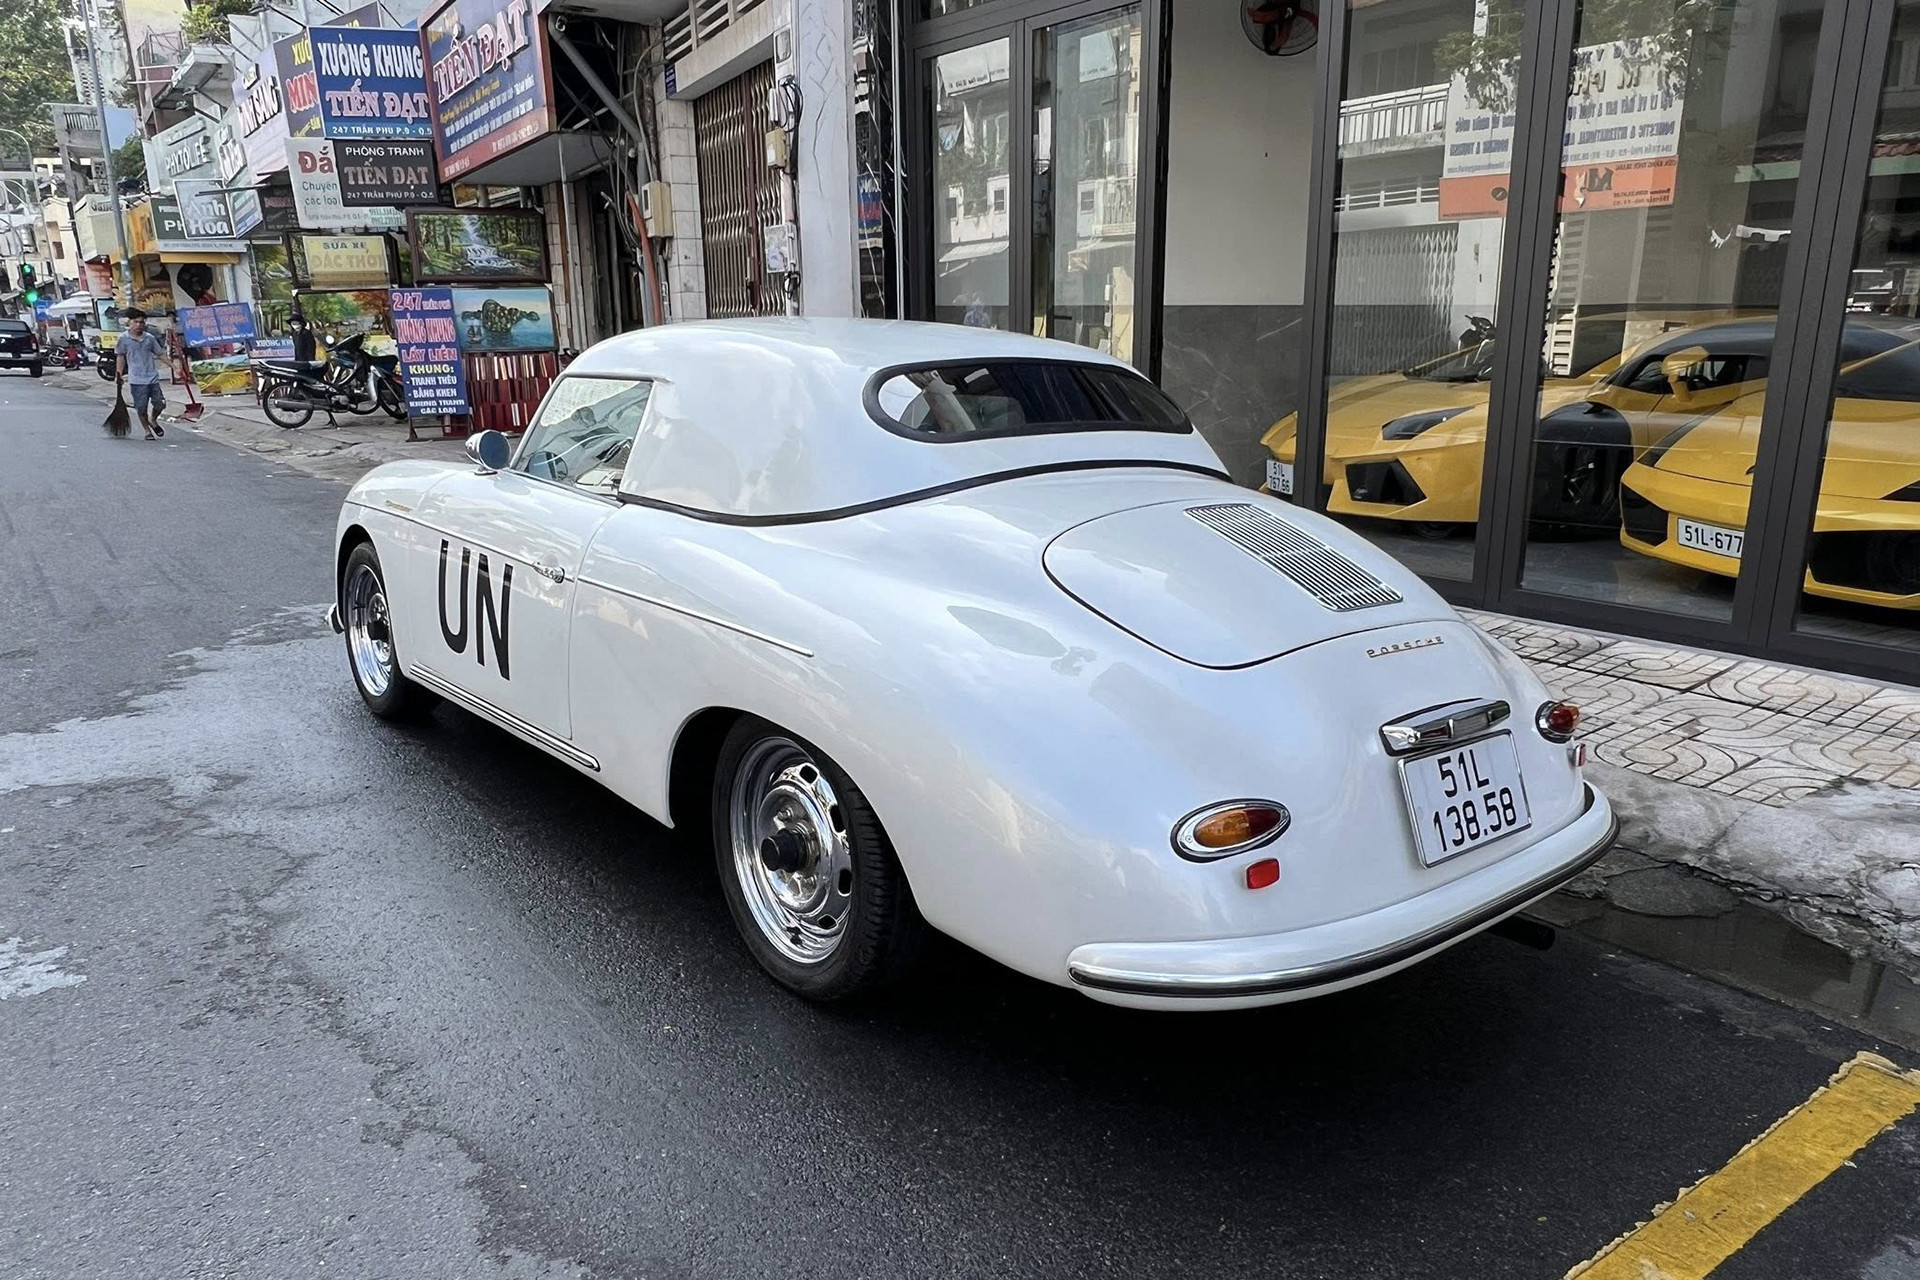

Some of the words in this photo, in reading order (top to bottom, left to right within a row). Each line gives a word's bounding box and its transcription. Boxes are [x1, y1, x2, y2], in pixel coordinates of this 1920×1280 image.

[372, 44, 424, 78] KHUNG
[325, 78, 380, 117] TIẾN
[383, 92, 428, 124] ĐẠT
[332, 126, 348, 135] 247
[387, 147, 424, 156] TRANH
[344, 157, 388, 185] TIẾN
[392, 166, 429, 190] ĐẠT
[392, 292, 422, 311] 247
[410, 377, 436, 386] TRANH
[436, 388, 457, 398] KHEN
[438, 538, 513, 681] UN
[1366, 636, 1444, 659] PORSCHE
[1437, 749, 1490, 798] 51L
[1433, 787, 1517, 852] 138.58
